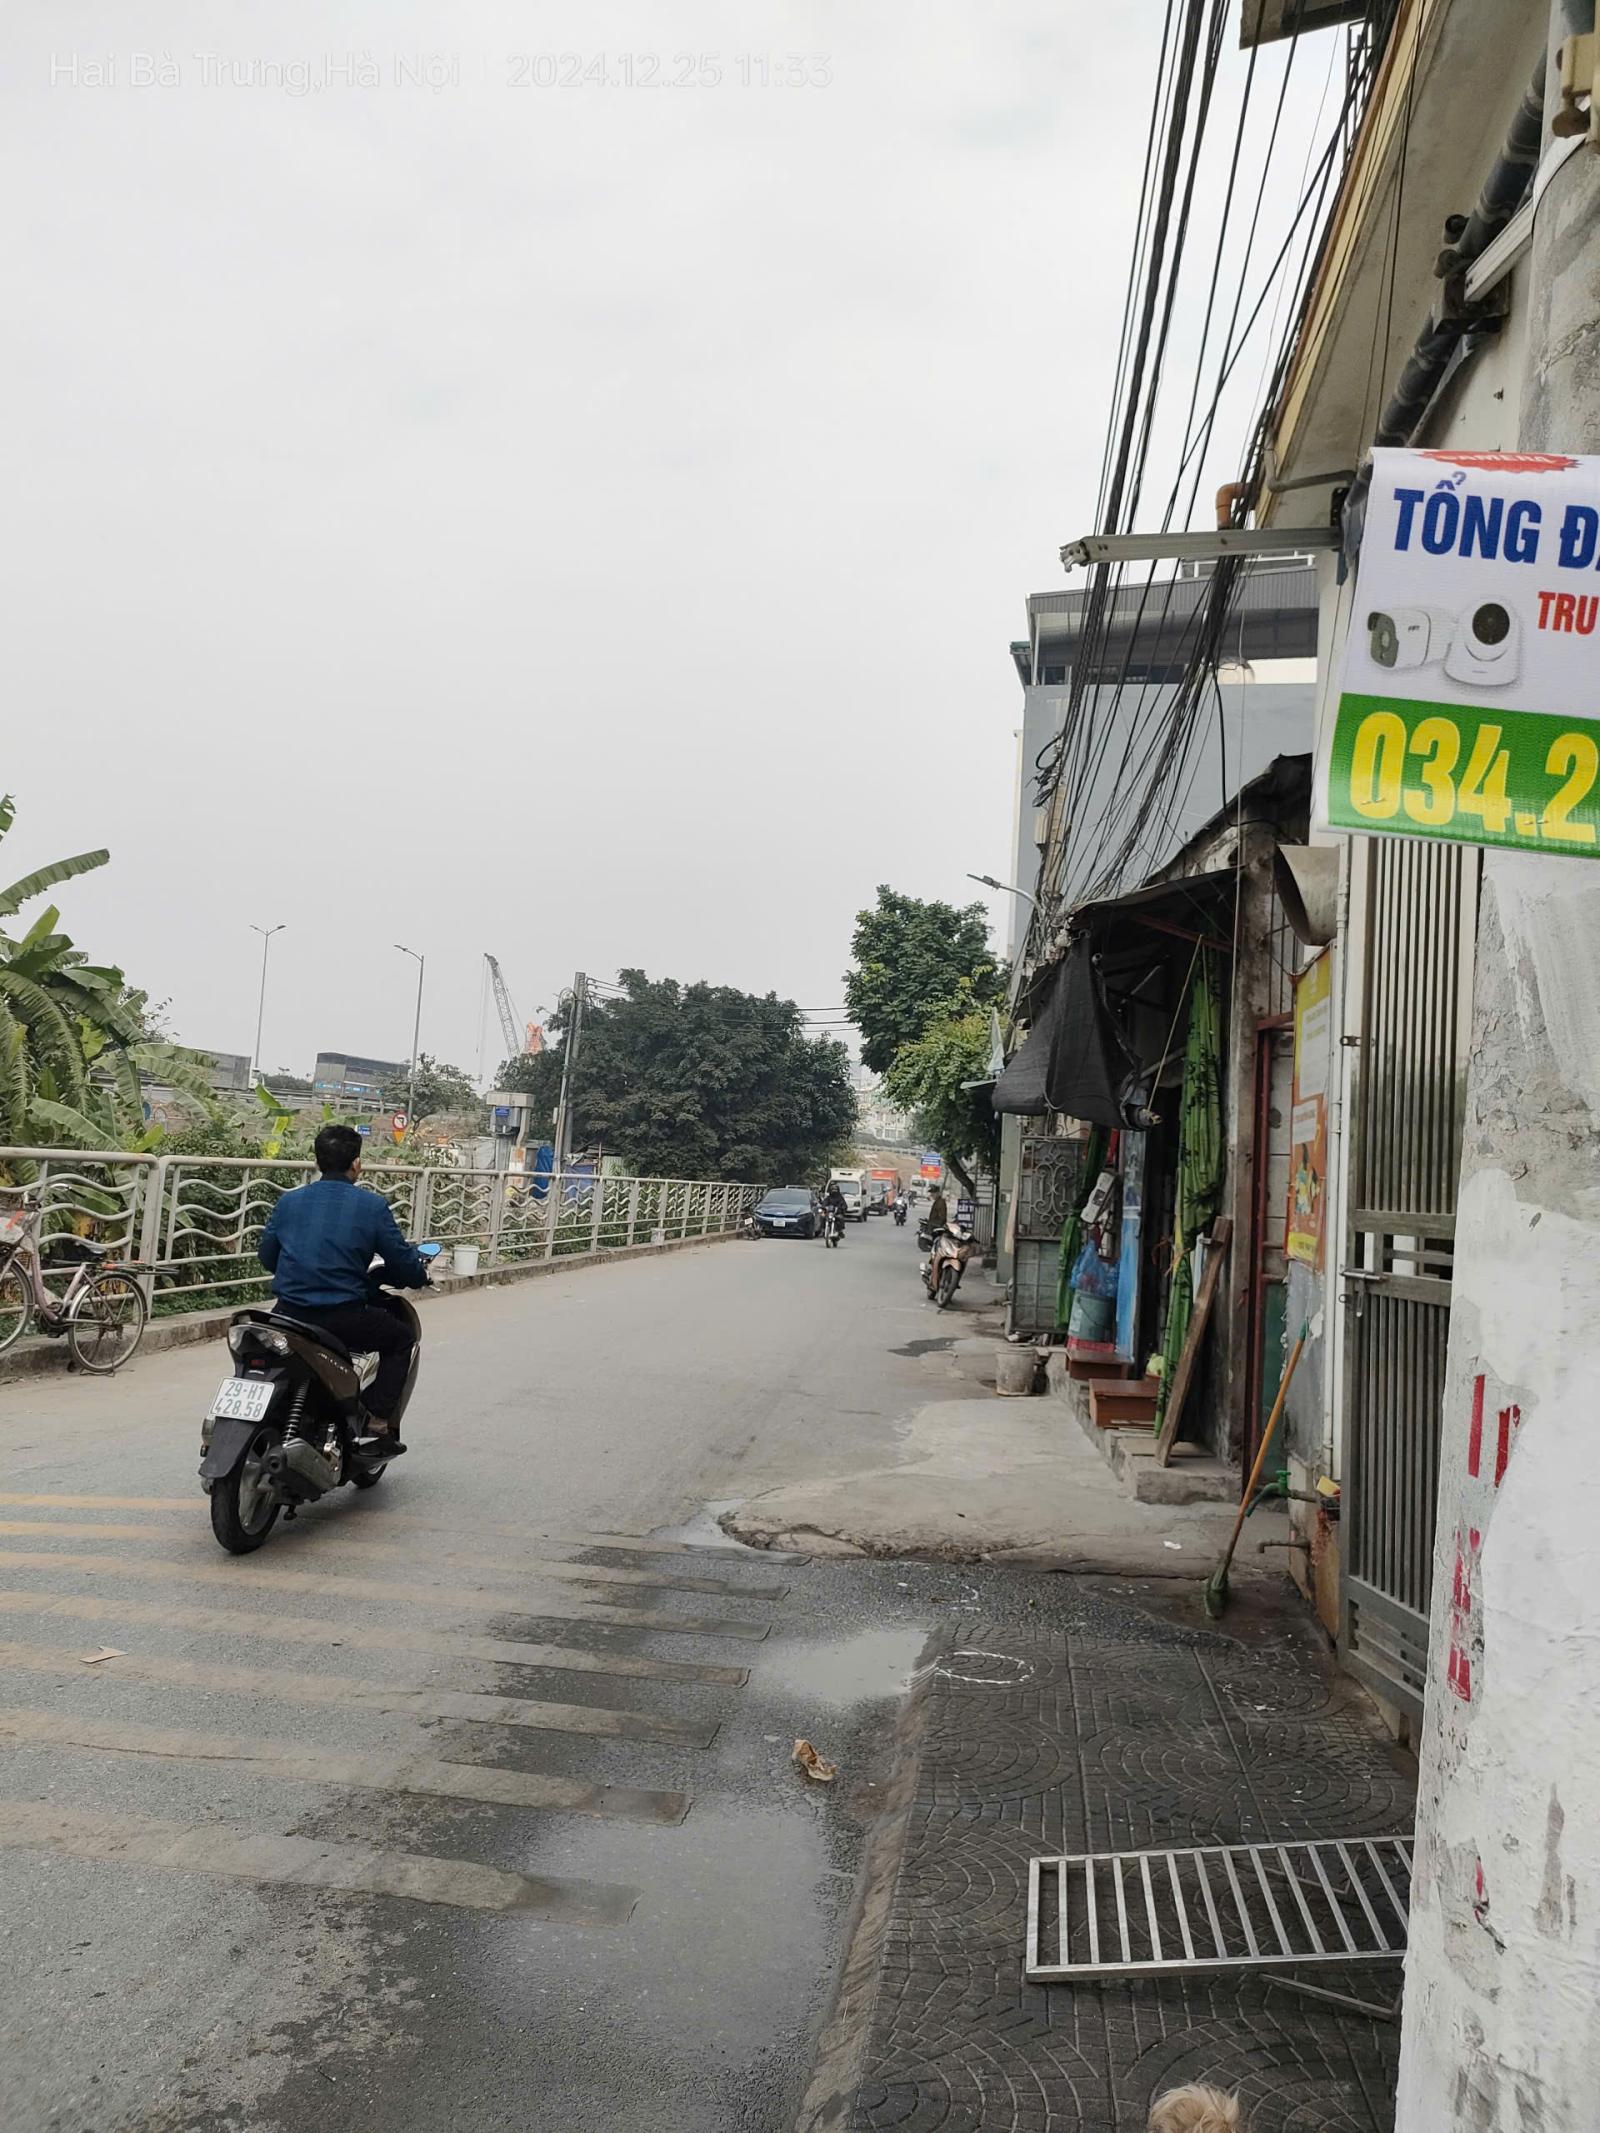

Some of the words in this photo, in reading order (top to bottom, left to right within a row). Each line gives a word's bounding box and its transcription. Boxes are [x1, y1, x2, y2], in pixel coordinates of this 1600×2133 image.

[1393, 471, 1542, 564] TỔNG
[1557, 505, 1600, 572] Đ
[1350, 711, 1599, 843] 034.2
[215, 1398, 263, 1418] 428.58
[225, 1381, 266, 1401] 29-H1
